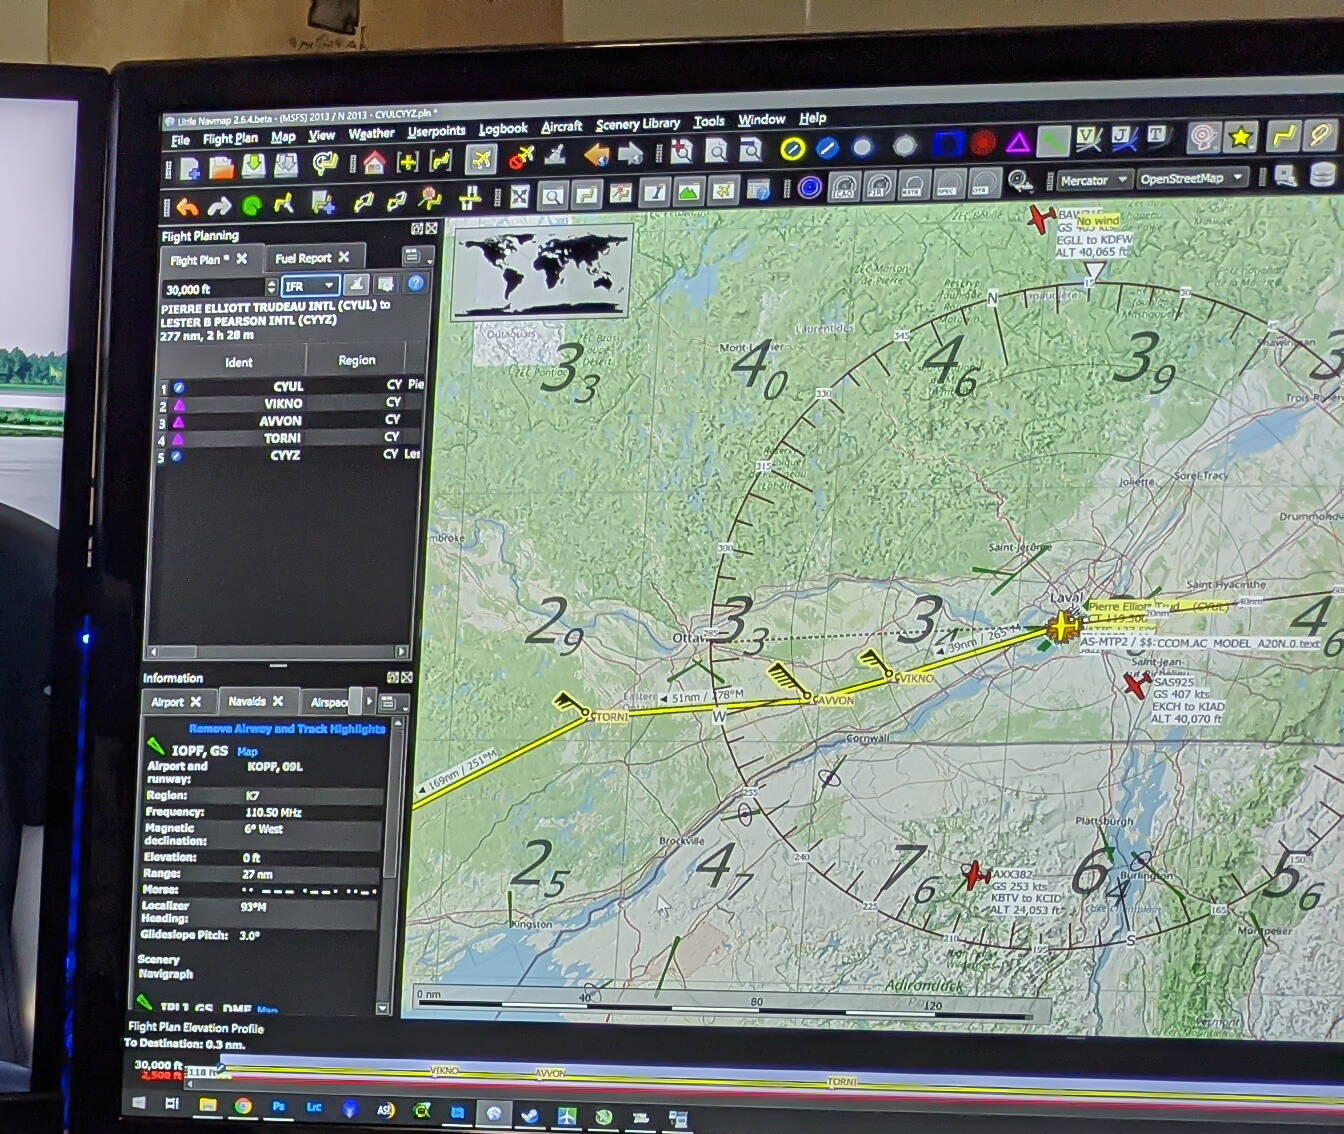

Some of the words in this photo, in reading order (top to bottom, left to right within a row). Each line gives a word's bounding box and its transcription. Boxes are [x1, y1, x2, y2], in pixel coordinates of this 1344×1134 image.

[171, 134, 190, 147] File
[203, 133, 232, 145] Flight
[234, 132, 258, 145] Plan
[271, 131, 296, 144] Map
[309, 129, 335, 142] View
[349, 127, 394, 139] Weather
[408, 124, 466, 139] Userpoints
[479, 122, 528, 136] Logbook
[541, 120, 583, 134] Aircraft
[596, 118, 640, 132] Scenery
[643, 117, 681, 130] Library
[693, 115, 725, 129] Tools
[738, 114, 785, 127] Window
[799, 111, 827, 125] Help
[1061, 175, 1109, 186] Mercator
[1141, 173, 1224, 186] OpenStreetMap
[1077, 216, 1092, 226] No
[1095, 216, 1120, 226] wind
[162, 230, 193, 242] Flight
[195, 229, 239, 242] Planning
[1057, 235, 1081, 246] EGLL
[1085, 236, 1097, 245] to
[1101, 234, 1133, 245] KDFW
[275, 252, 296, 264] Fuel
[299, 252, 332, 266] Report
[166, 284, 199, 296] 30,000
[201, 284, 210, 294] ft
[286, 282, 303, 291] IFR
[161, 304, 202, 315] PIERRE
[204, 302, 250, 313] ELLIOTT
[252, 302, 305, 312] TRUDEAU
[308, 302, 335, 311] INTL
[338, 299, 377, 312] (CYUL)
[380, 300, 390, 309] to
[161, 317, 200, 328] LESTER
[203, 317, 211, 327] B
[214, 316, 266, 327] PEARSON
[269, 316, 294, 325] INTL
[297, 314, 337, 327] (CYYZ)
[225, 357, 253, 368] Ident
[339, 355, 376, 367] Region
[273, 382, 304, 392] CYUL
[265, 398, 303, 409] VIKNO
[260, 416, 302, 426] AVVON
[264, 433, 301, 443] TORNI
[271, 450, 300, 460] CYYZ
[1050, 592, 1083, 603] Laval
[144, 673, 203, 684] Information
[1154, 678, 1194, 687] SAS925
[1154, 690, 1169, 699] GS
[1173, 690, 1191, 699] 407
[1194, 690, 1210, 699] kts
[152, 698, 184, 708] Airport
[229, 696, 266, 706] Navaids
[1153, 702, 1181, 712] EKCH
[1185, 703, 1195, 711] to
[1199, 702, 1225, 712] KIAD
[1152, 714, 1170, 723] ALT
[1174, 714, 1208, 725] 40,070
[1212, 714, 1222, 723] ft
[847, 734, 890, 743] Cornwall
[146, 808, 204, 818] Frequency:
[246, 808, 278, 818] 110.50
[281, 808, 302, 818] MHz
[1076, 817, 1134, 828] Plattsburgh
[994, 869, 1032, 879] AXX382
[142, 901, 189, 911] Localizer
[142, 913, 188, 924] Heading:
[138, 955, 180, 966] Scenery
[139, 969, 193, 980] Navigraph
[129, 1021, 157, 1033] Flight
[160, 1023, 181, 1033] Plan
[183, 1023, 229, 1033] Elevation
[232, 1024, 264, 1034] Profile
